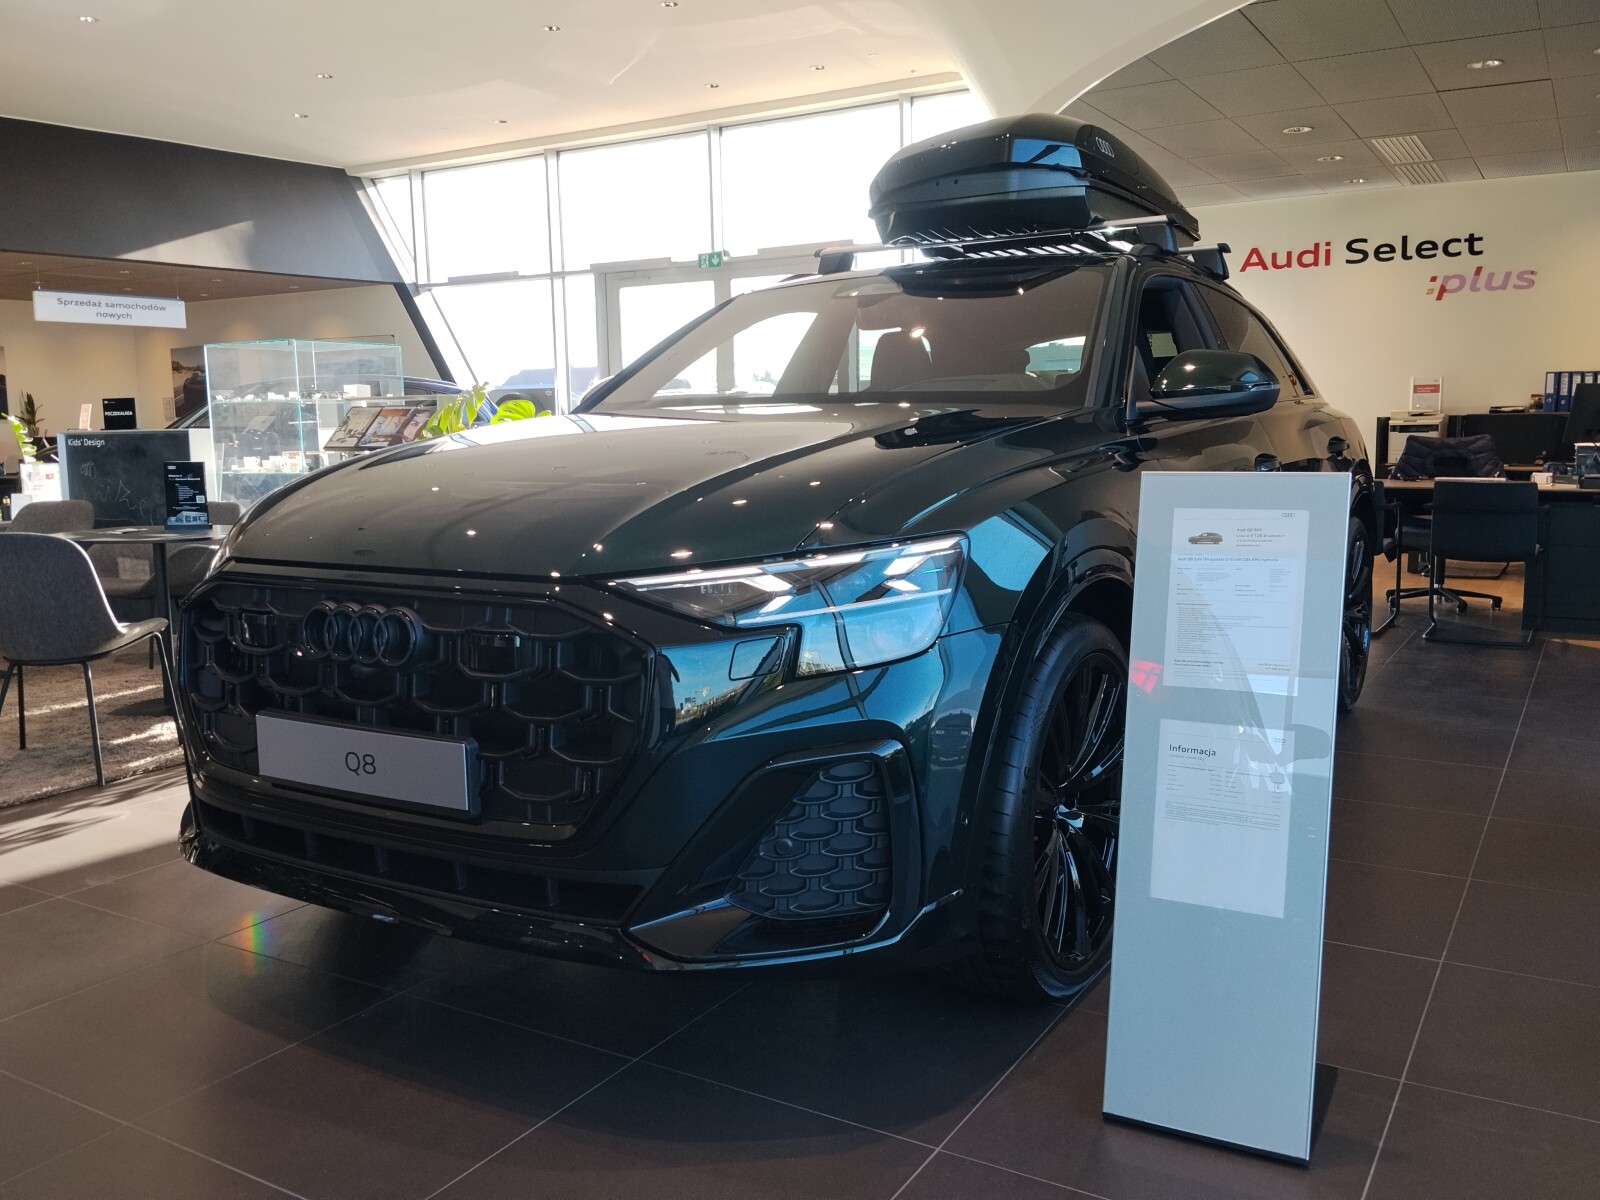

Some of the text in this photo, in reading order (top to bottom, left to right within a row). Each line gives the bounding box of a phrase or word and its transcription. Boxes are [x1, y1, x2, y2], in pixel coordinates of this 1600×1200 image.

[1239, 233, 1484, 272] Audi Select
[57, 297, 167, 312] Sprzedaż samochodów
[96, 311, 133, 321] nowych
[83, 438, 105, 448] Design
[1169, 744, 1216, 758] Informacja
[345, 751, 376, 776] Q8
